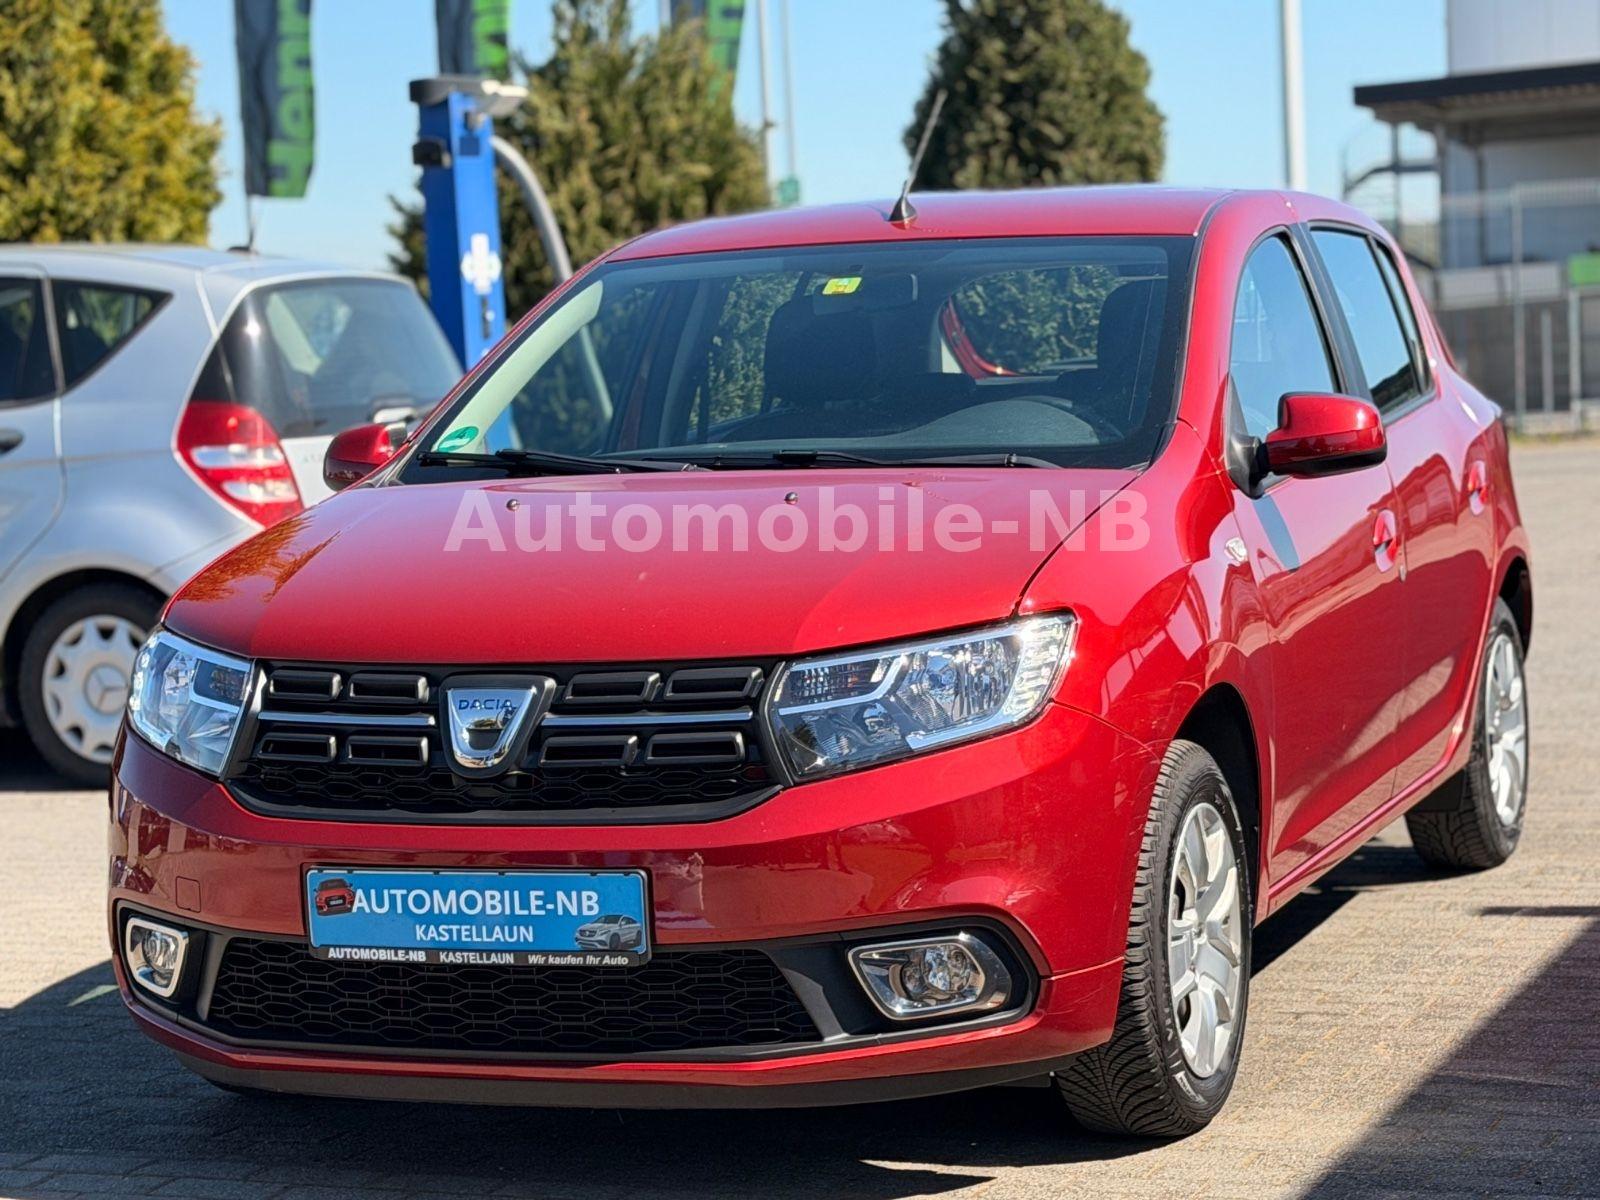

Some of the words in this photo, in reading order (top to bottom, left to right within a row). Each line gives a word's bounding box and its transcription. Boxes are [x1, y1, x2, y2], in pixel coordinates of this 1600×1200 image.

[458, 699, 513, 710] DACIA
[352, 888, 600, 917] AUTOMOBILE-NB
[415, 924, 534, 943] KASTELLAUN
[328, 947, 427, 962] AUTOMOBILE-NB
[439, 952, 514, 964] KASTELLAUN
[527, 954, 545, 965] Wir
[548, 954, 583, 965] kaufen
[586, 955, 600, 966] Ihr
[603, 955, 629, 966] Auto
